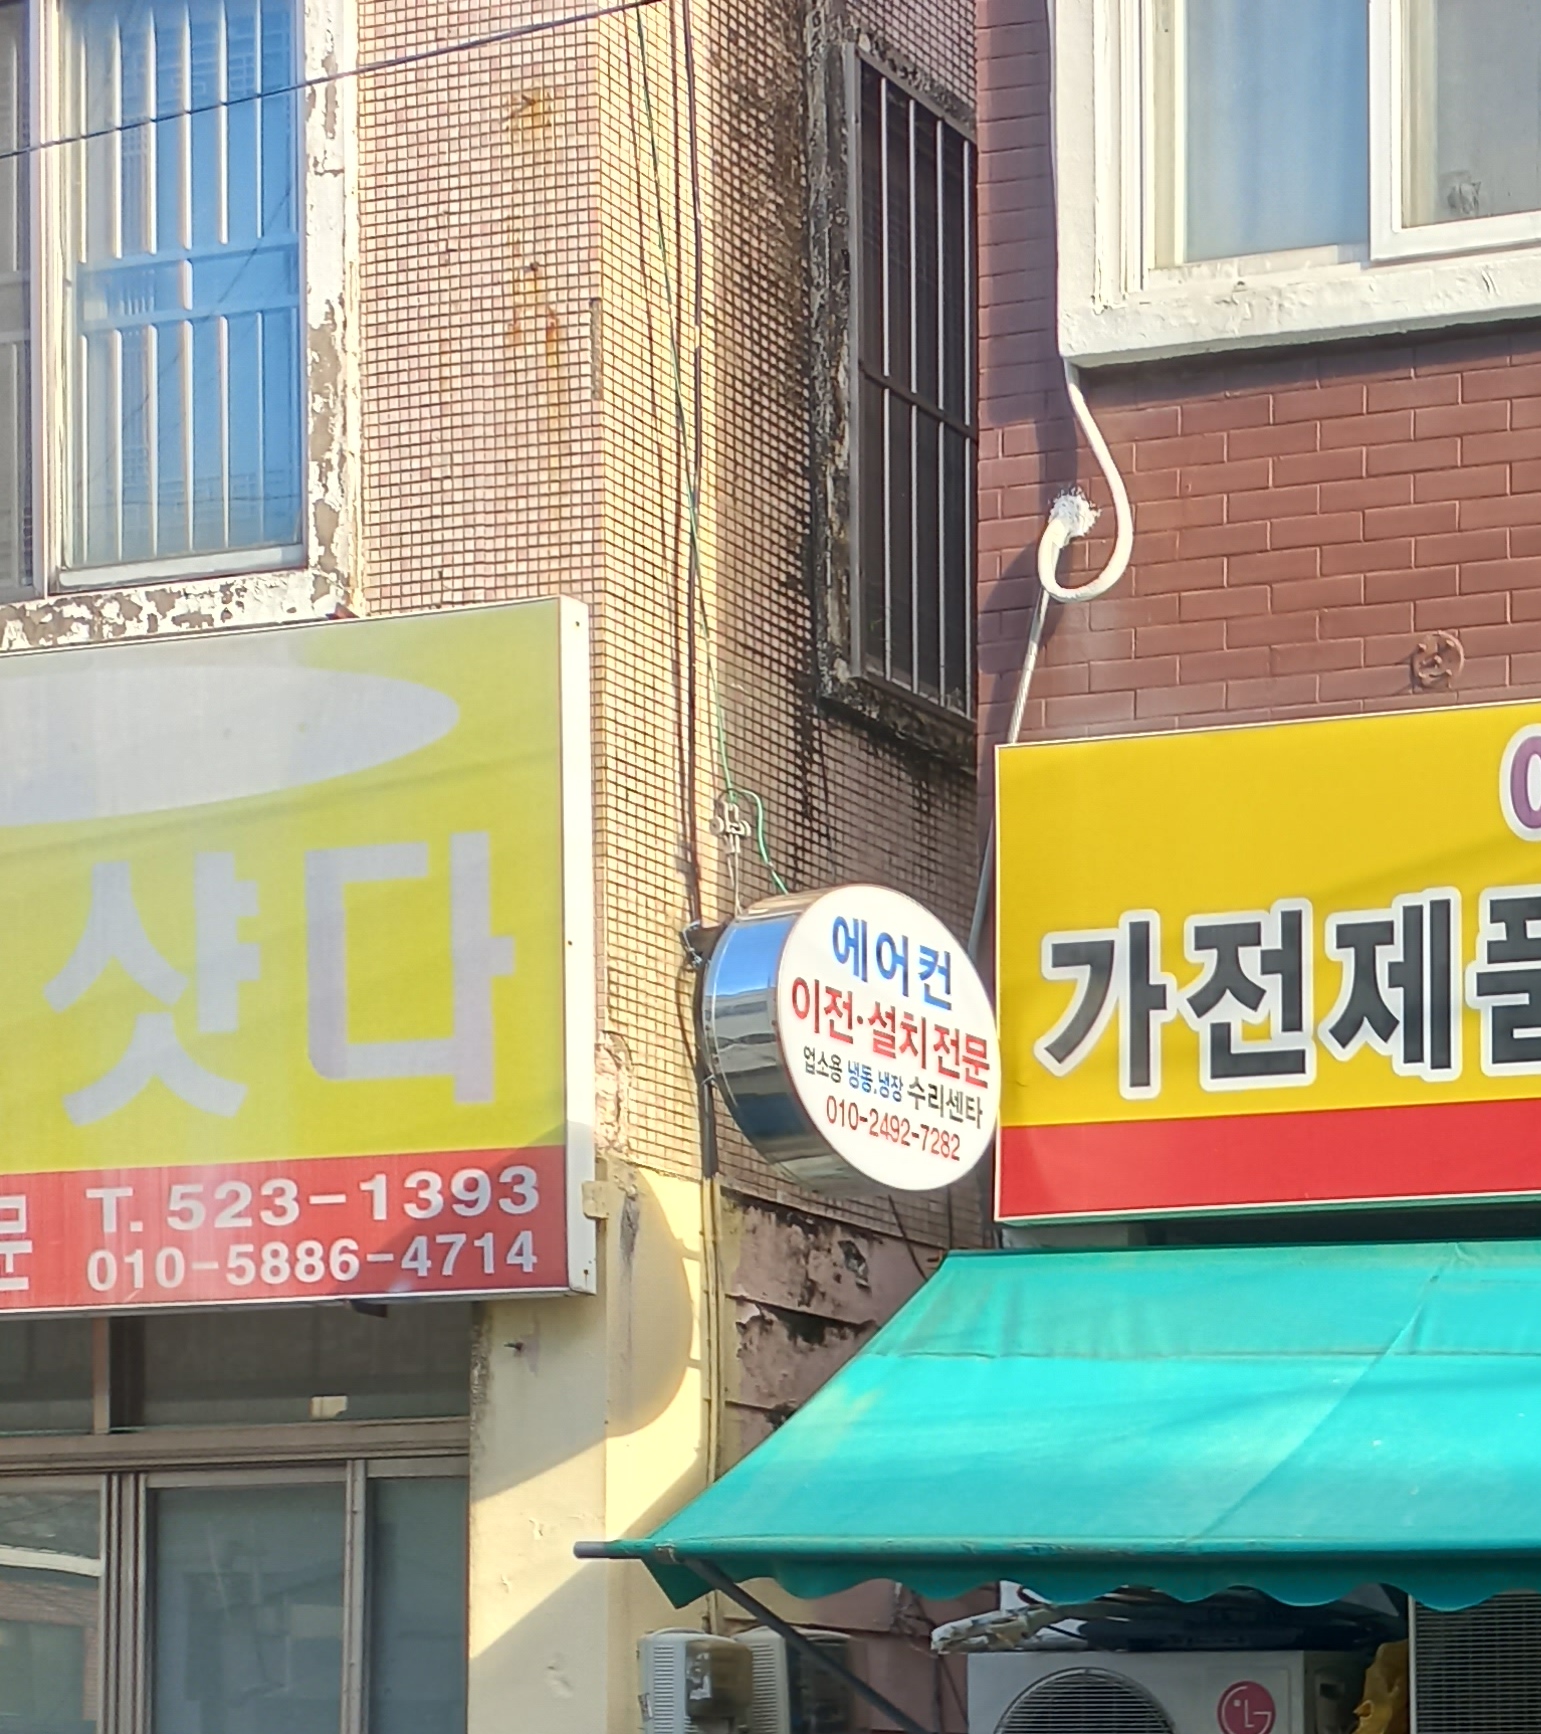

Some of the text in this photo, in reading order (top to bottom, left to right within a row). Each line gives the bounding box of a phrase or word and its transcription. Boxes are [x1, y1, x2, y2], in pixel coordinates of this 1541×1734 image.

[832, 915, 952, 1010] 에어컨
[803, 1045, 842, 1083] 업소용
[906, 1076, 983, 1129] 수리센타
[826, 1094, 961, 1161] 010-2492-7282
[167, 1164, 540, 1229] 523-1393
[86, 1228, 539, 1293] 010-5886-4714
